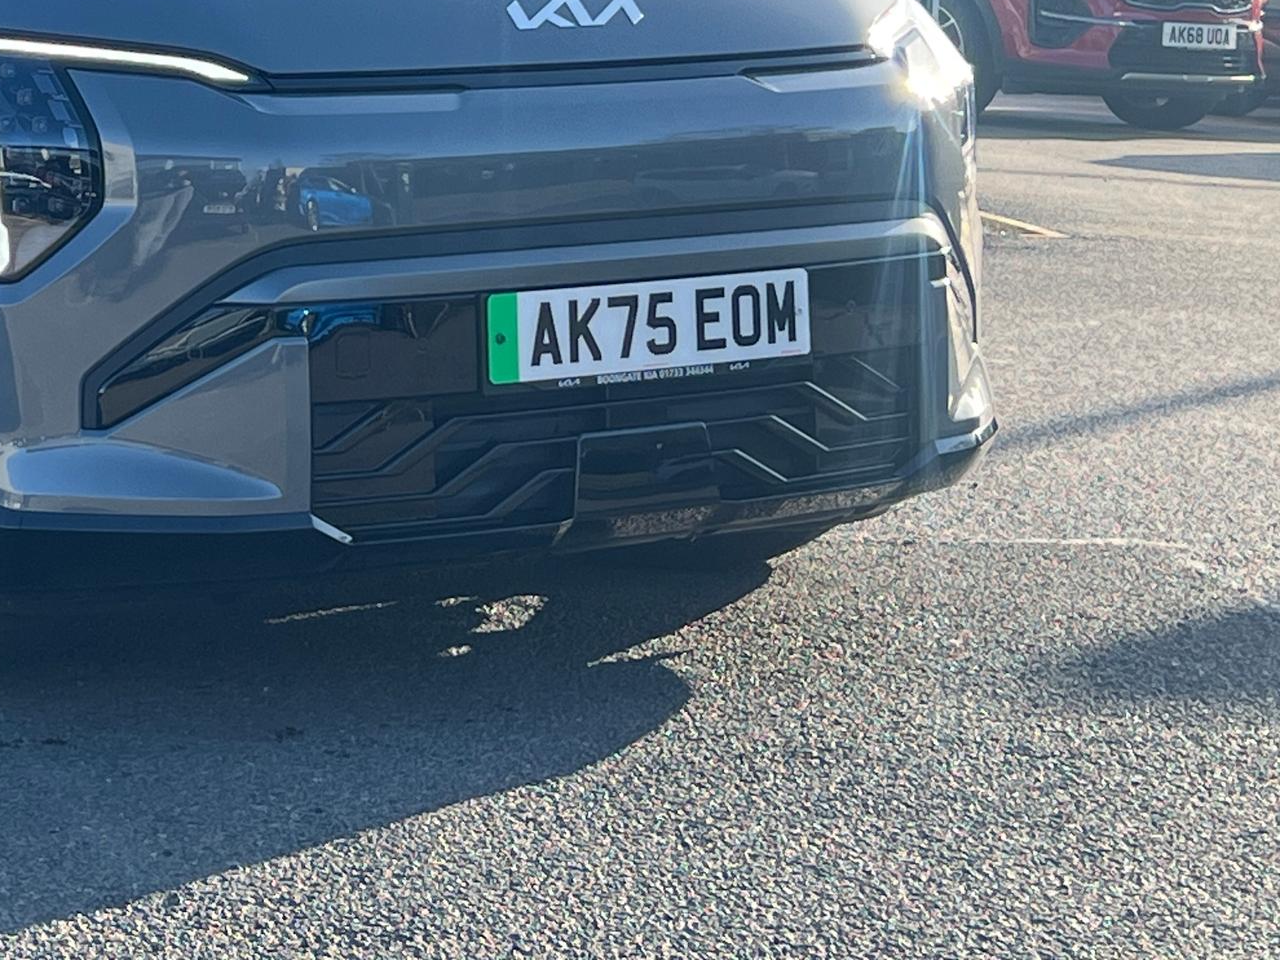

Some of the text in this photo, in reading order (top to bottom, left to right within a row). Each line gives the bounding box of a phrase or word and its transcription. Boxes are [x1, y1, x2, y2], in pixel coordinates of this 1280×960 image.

[1169, 26, 1204, 44] AK68
[531, 281, 798, 367] AK75 EOM
